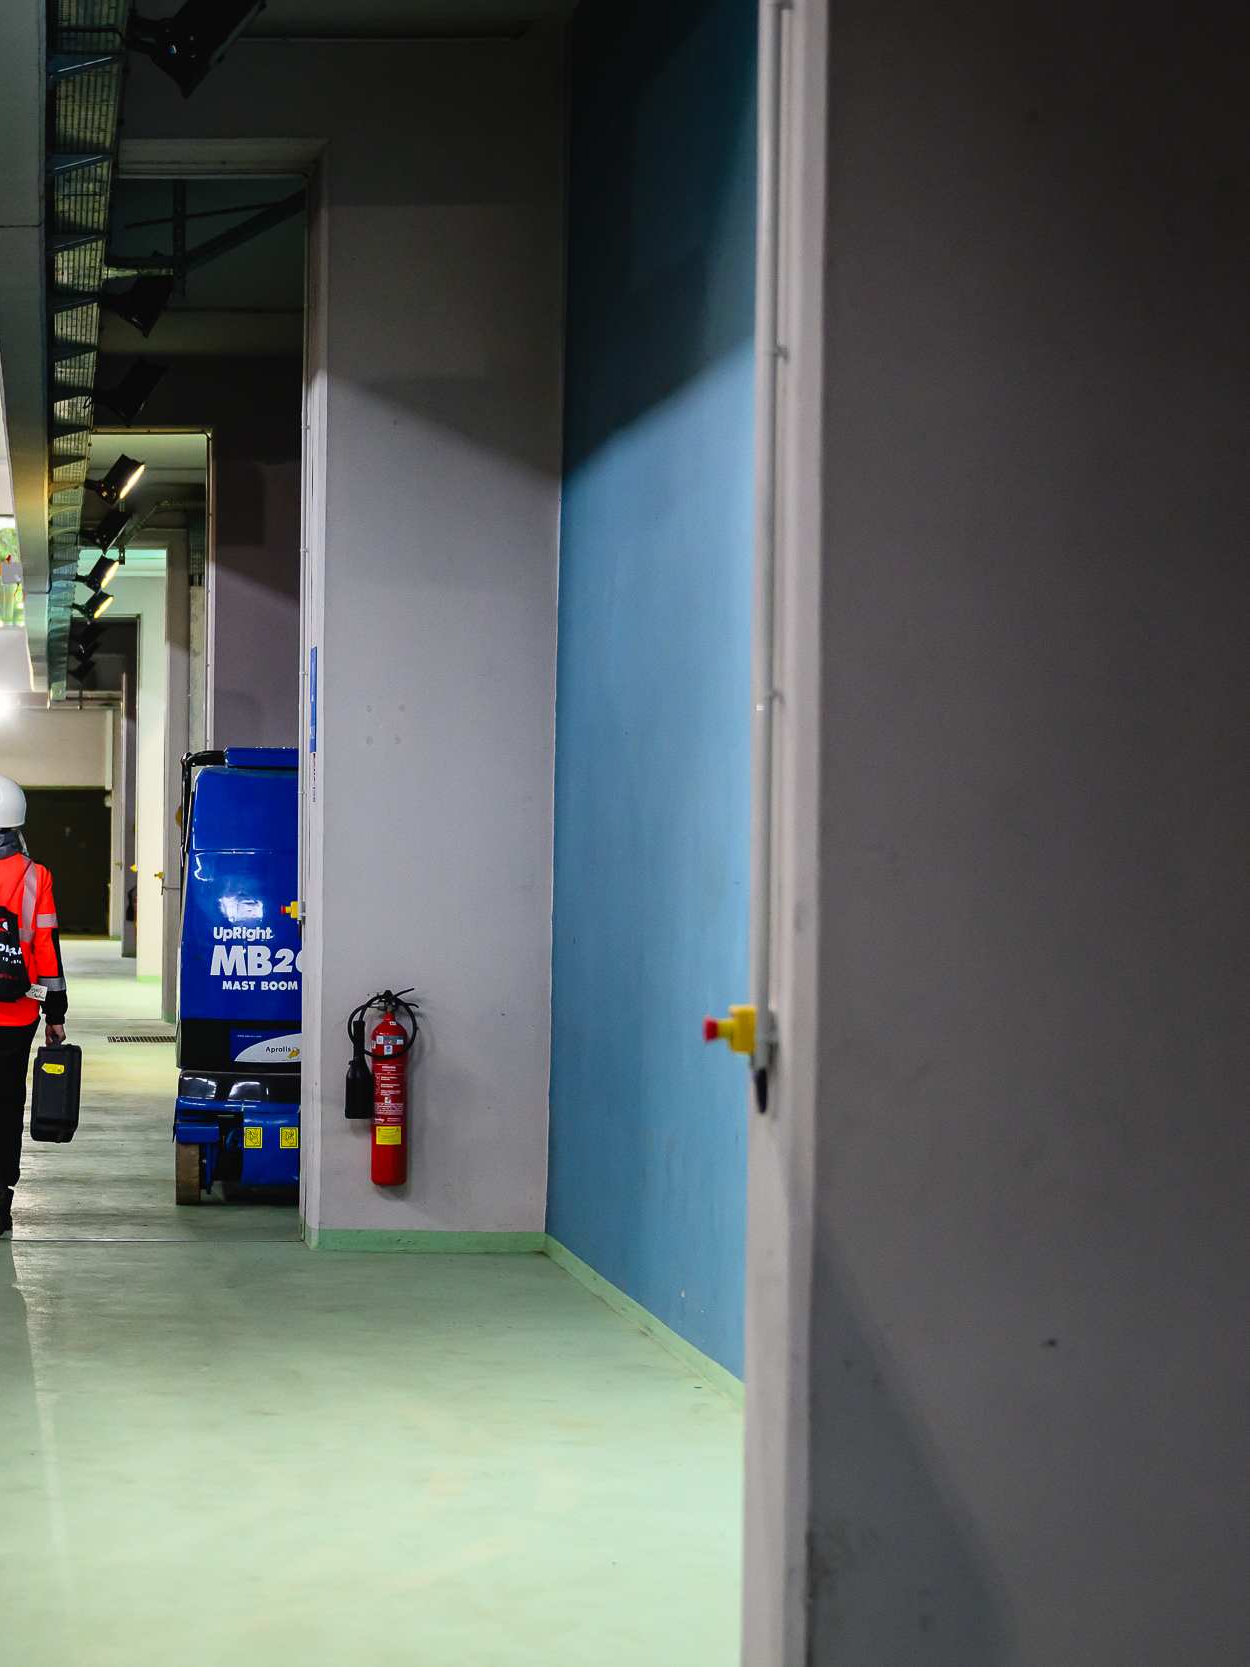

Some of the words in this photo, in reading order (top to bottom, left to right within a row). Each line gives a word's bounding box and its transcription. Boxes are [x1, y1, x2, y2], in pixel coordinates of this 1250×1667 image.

[213, 926, 272, 942] UpRight
[222, 980, 256, 991] MAST
[260, 980, 298, 991] BOOM
